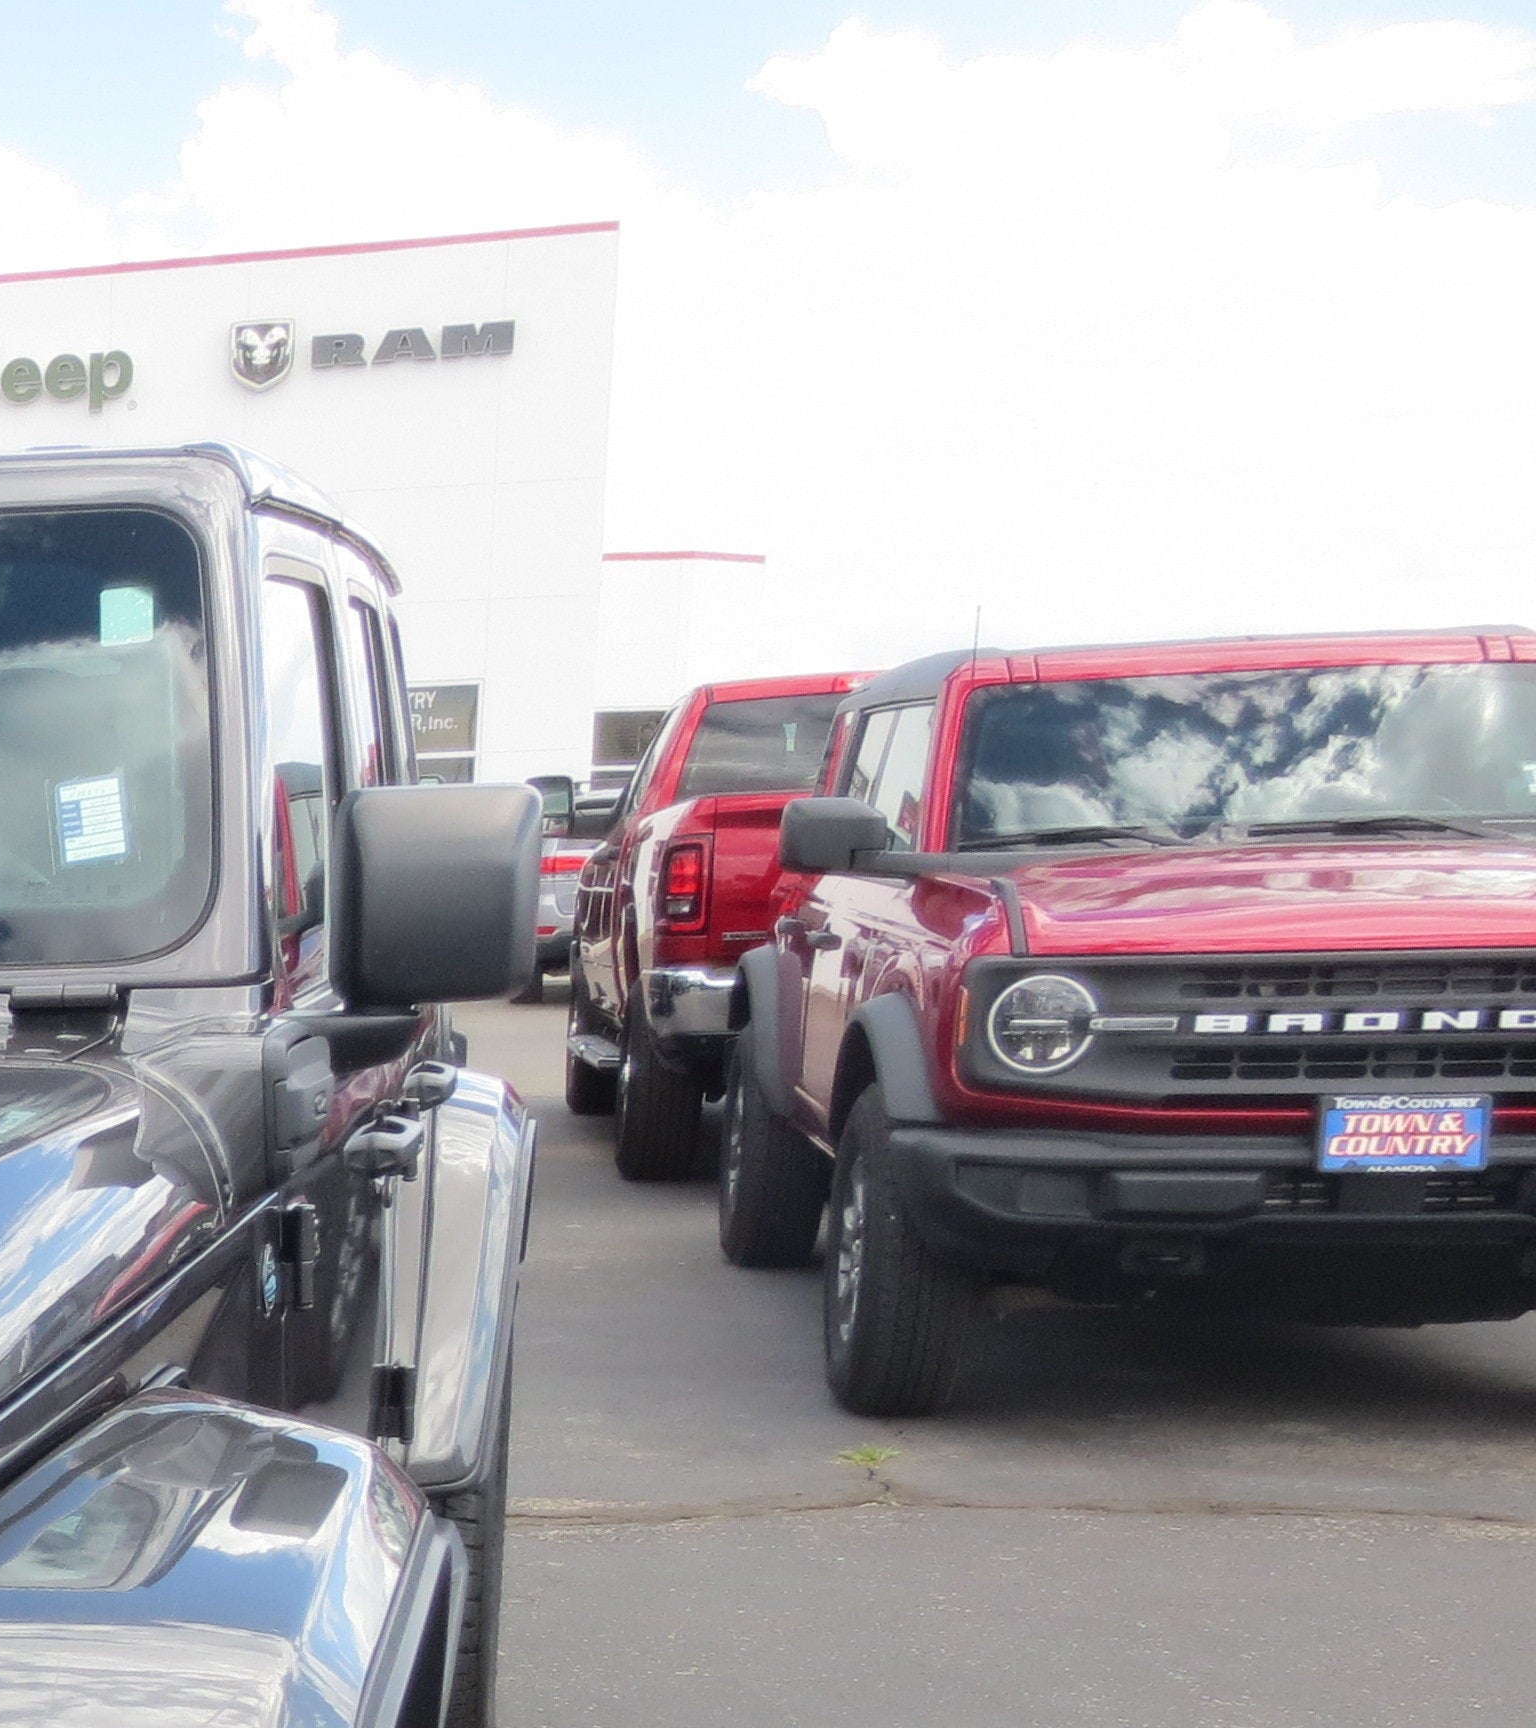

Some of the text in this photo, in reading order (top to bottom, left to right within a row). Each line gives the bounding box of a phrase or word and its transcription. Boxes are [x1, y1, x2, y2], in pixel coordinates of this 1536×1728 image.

[312, 319, 516, 369] RAM
[1343, 1111, 1464, 1134] TOWN &
[1327, 1133, 1479, 1157] COUNTRY
